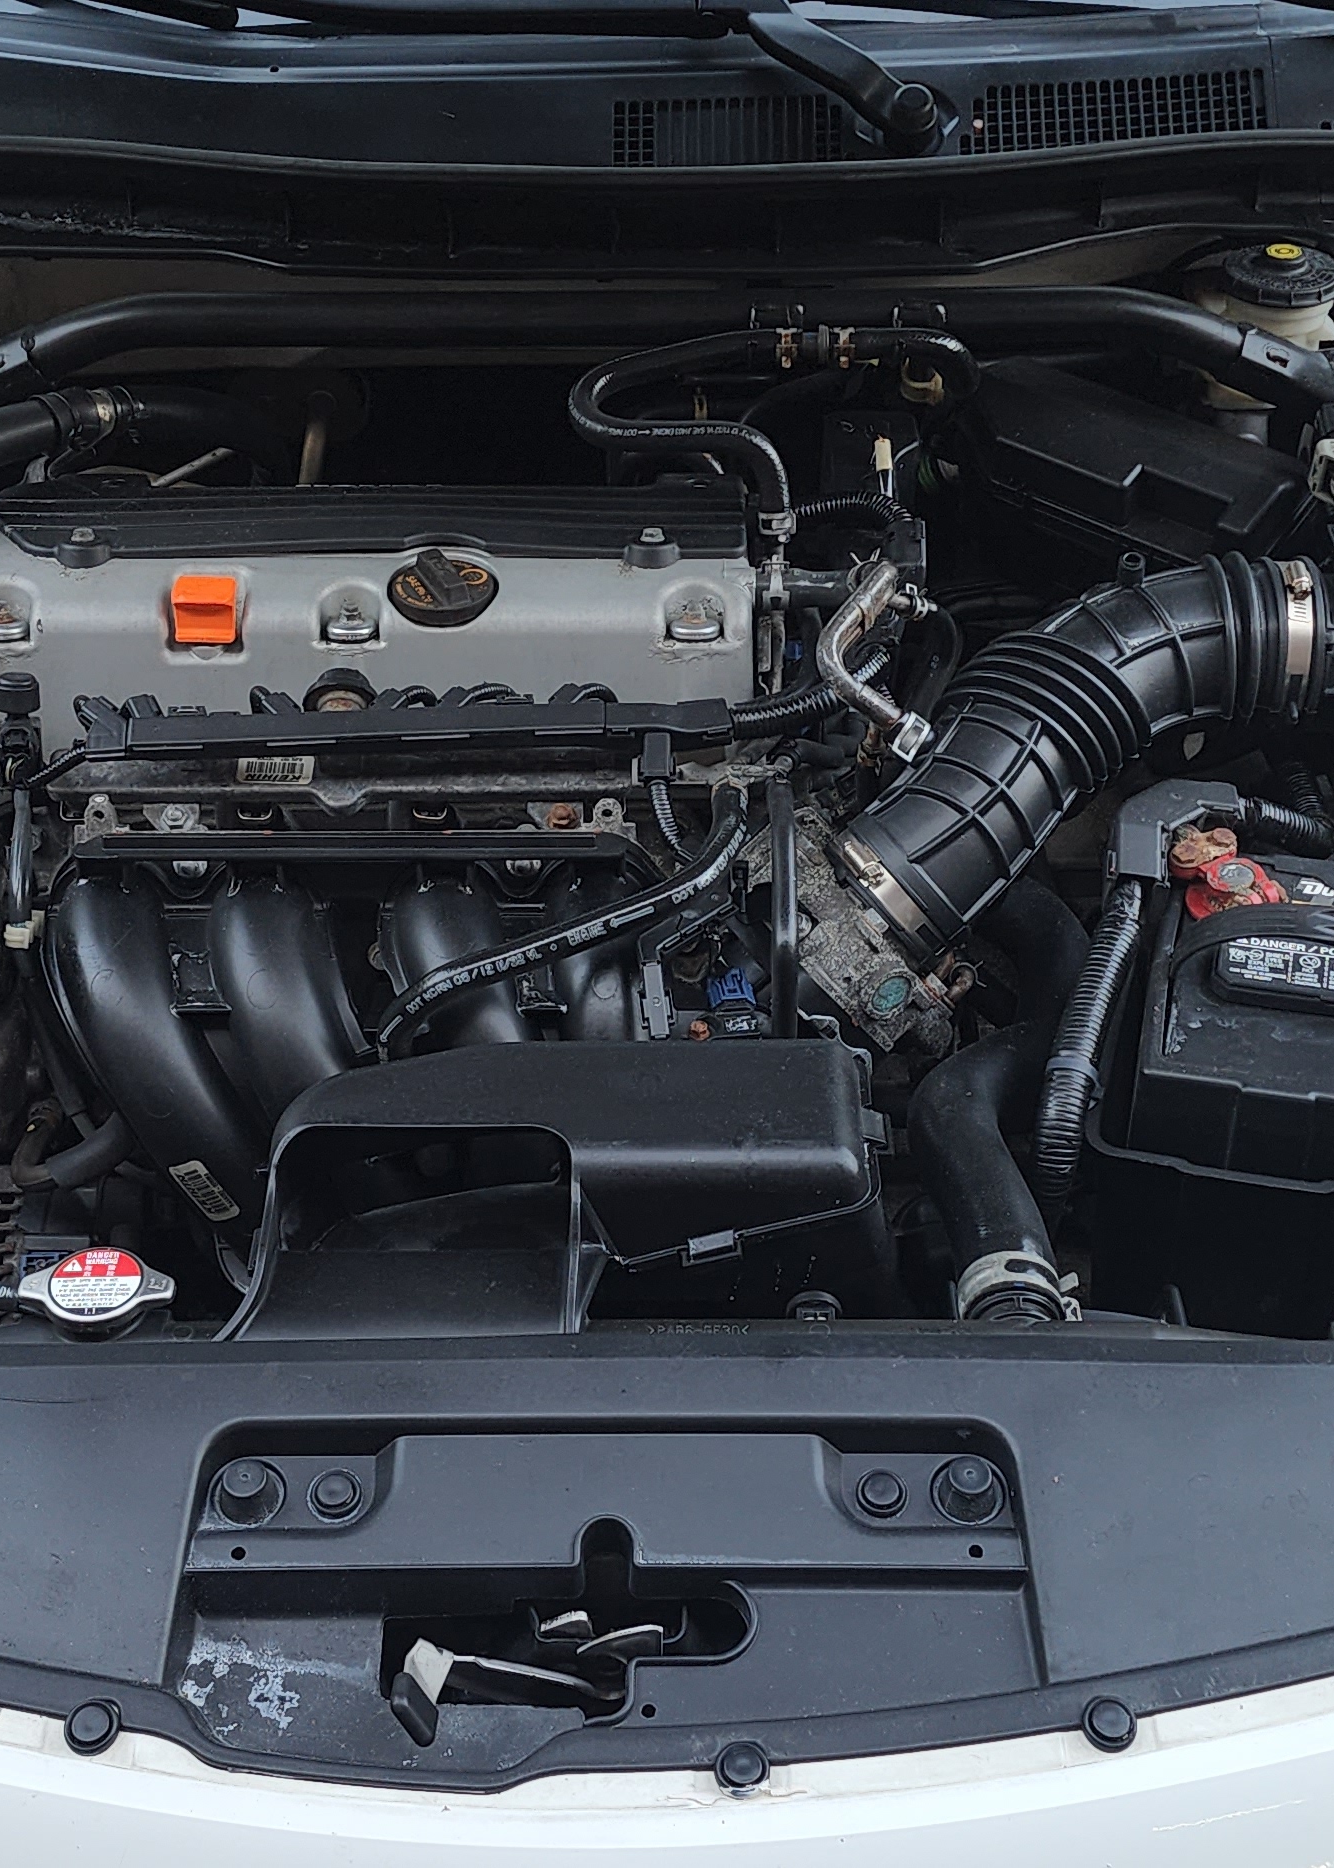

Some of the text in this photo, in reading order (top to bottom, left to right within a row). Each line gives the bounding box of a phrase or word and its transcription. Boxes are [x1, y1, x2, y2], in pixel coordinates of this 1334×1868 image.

[1250, 937, 1306, 952] DANGER
[405, 996, 424, 1015] DOT
[86, 1251, 120, 1259] DANGER
